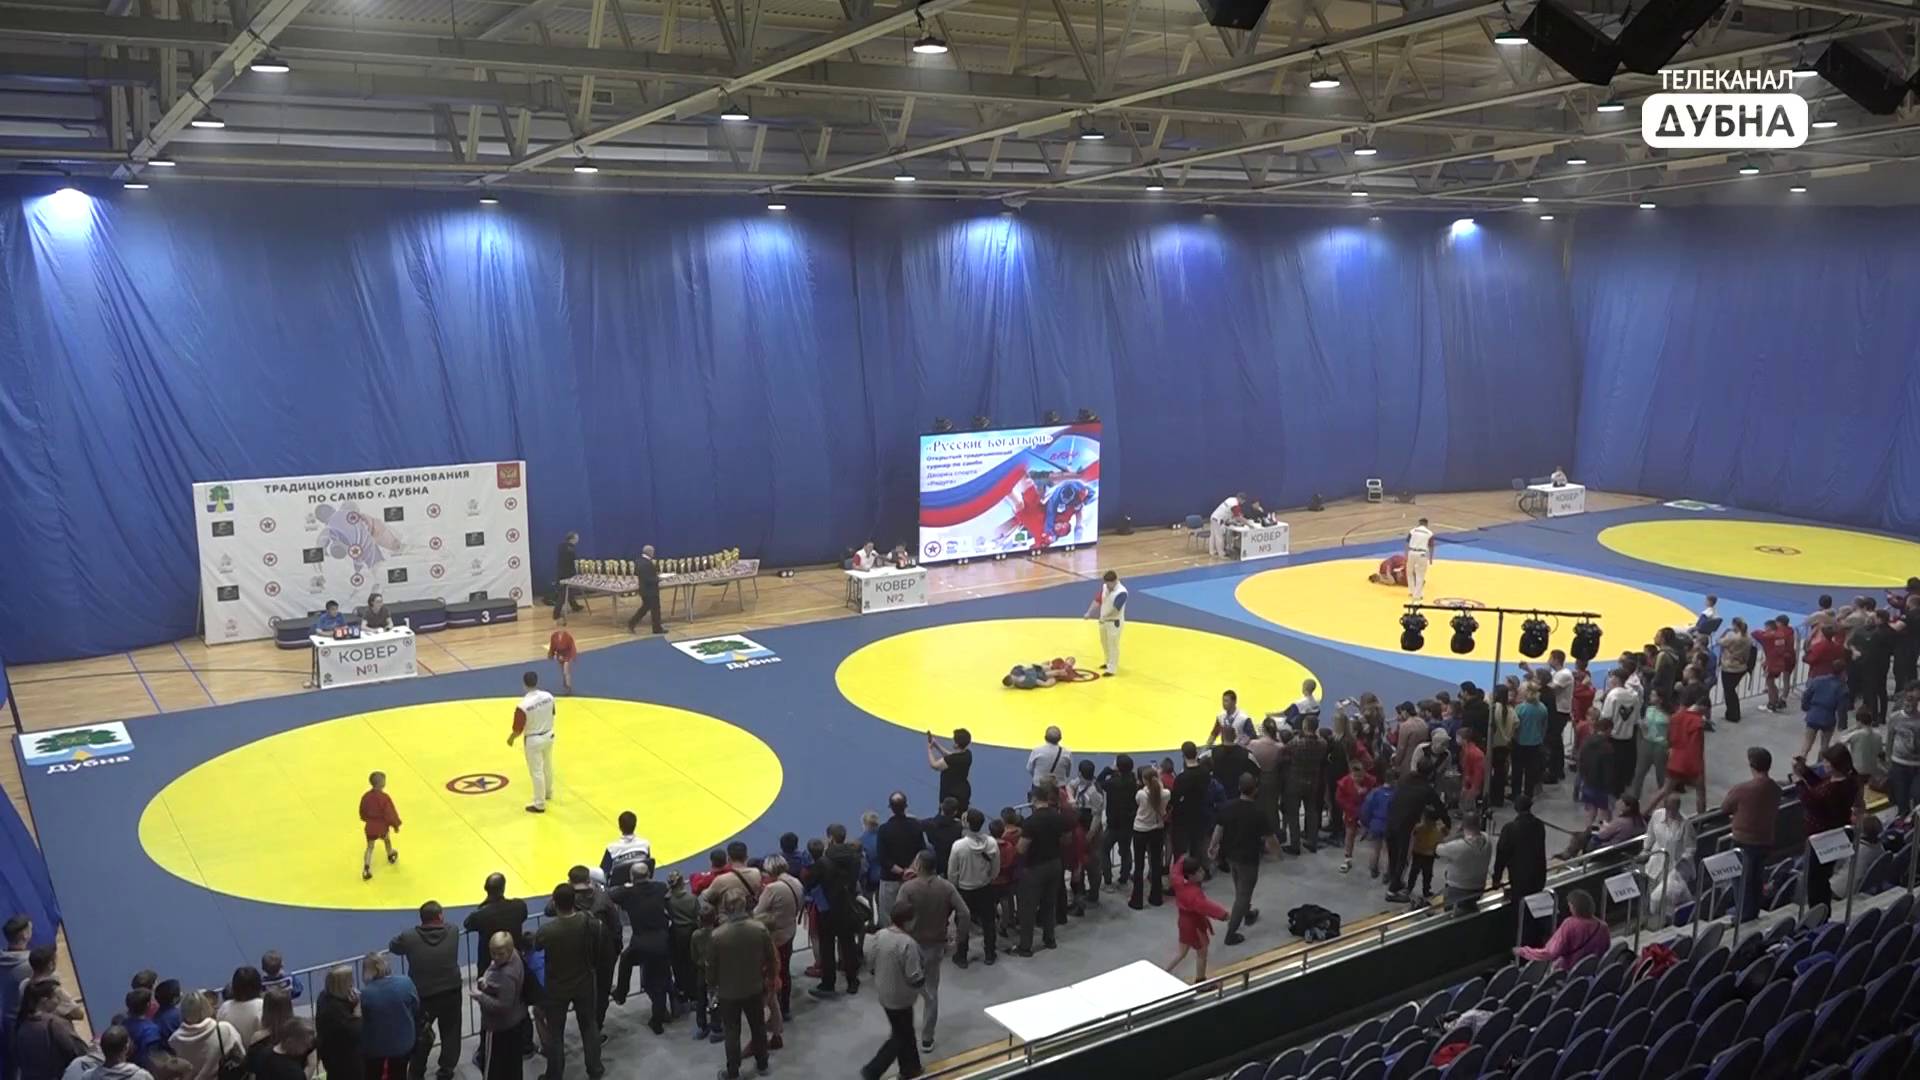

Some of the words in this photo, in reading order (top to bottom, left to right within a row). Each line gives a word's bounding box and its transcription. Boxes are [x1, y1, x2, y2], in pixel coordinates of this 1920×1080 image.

[264, 474, 371, 494] ТРАДИЦИОННЫЕ
[374, 470, 470, 486] СОРЕВНОВАНИЯ
[308, 493, 326, 504] ПО
[329, 490, 375, 502] САМБО
[388, 486, 429, 499] ДУБНА
[1250, 530, 1281, 544] КОВЕР
[875, 578, 916, 593] КОВЕР
[886, 592, 905, 604] №2
[481, 610, 491, 623] 3
[338, 644, 398, 664] КОВЕР
[355, 663, 379, 676] №1
[47, 755, 131, 774] Дубна
